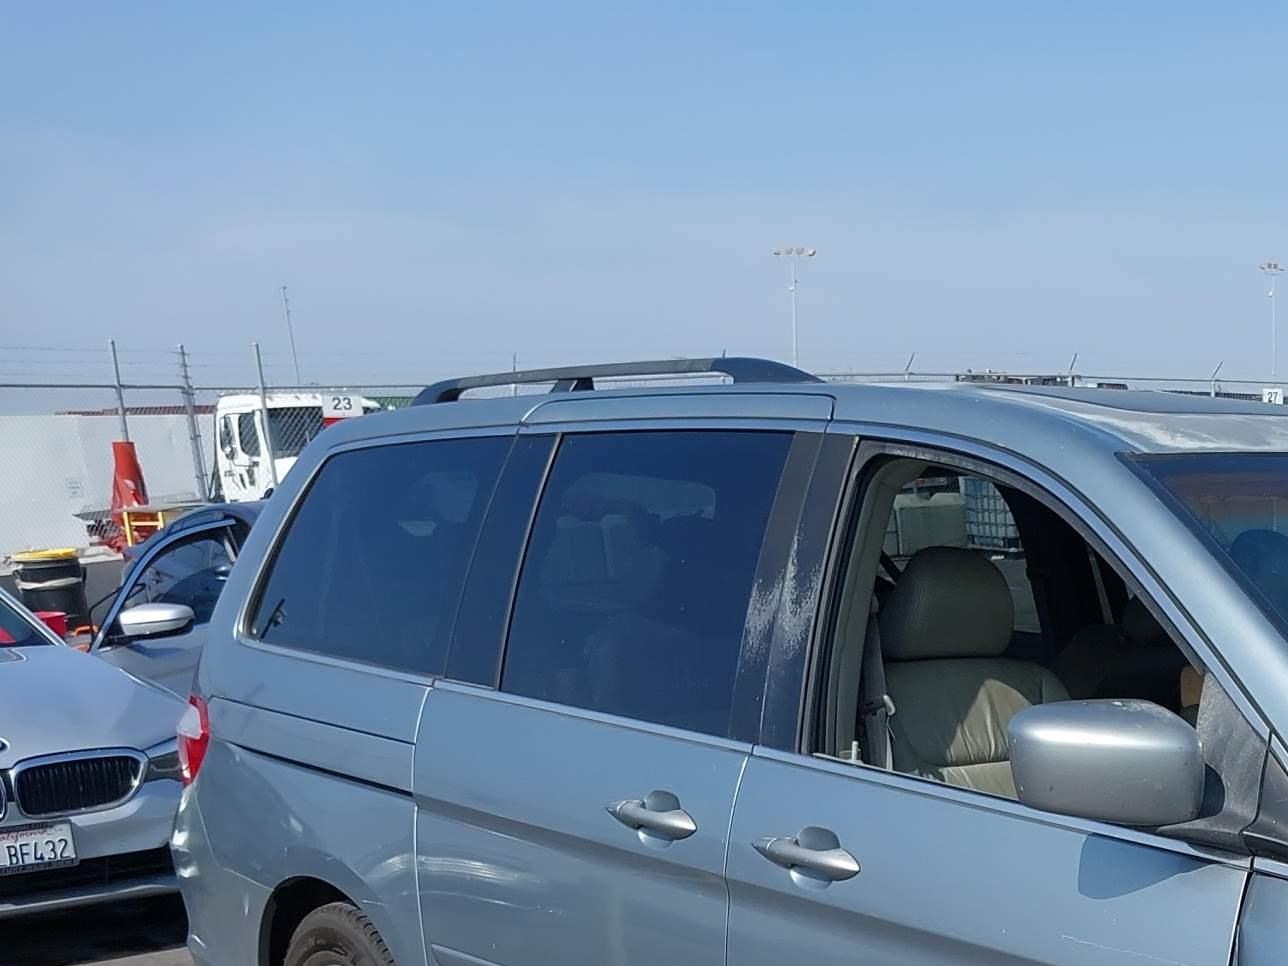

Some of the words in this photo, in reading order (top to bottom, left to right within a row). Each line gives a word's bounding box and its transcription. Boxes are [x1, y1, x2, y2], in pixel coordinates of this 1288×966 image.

[332, 397, 353, 411] 23
[1267, 392, 1278, 403] 27
[0, 828, 48, 843] alifornia
[0, 838, 70, 867] BF432
